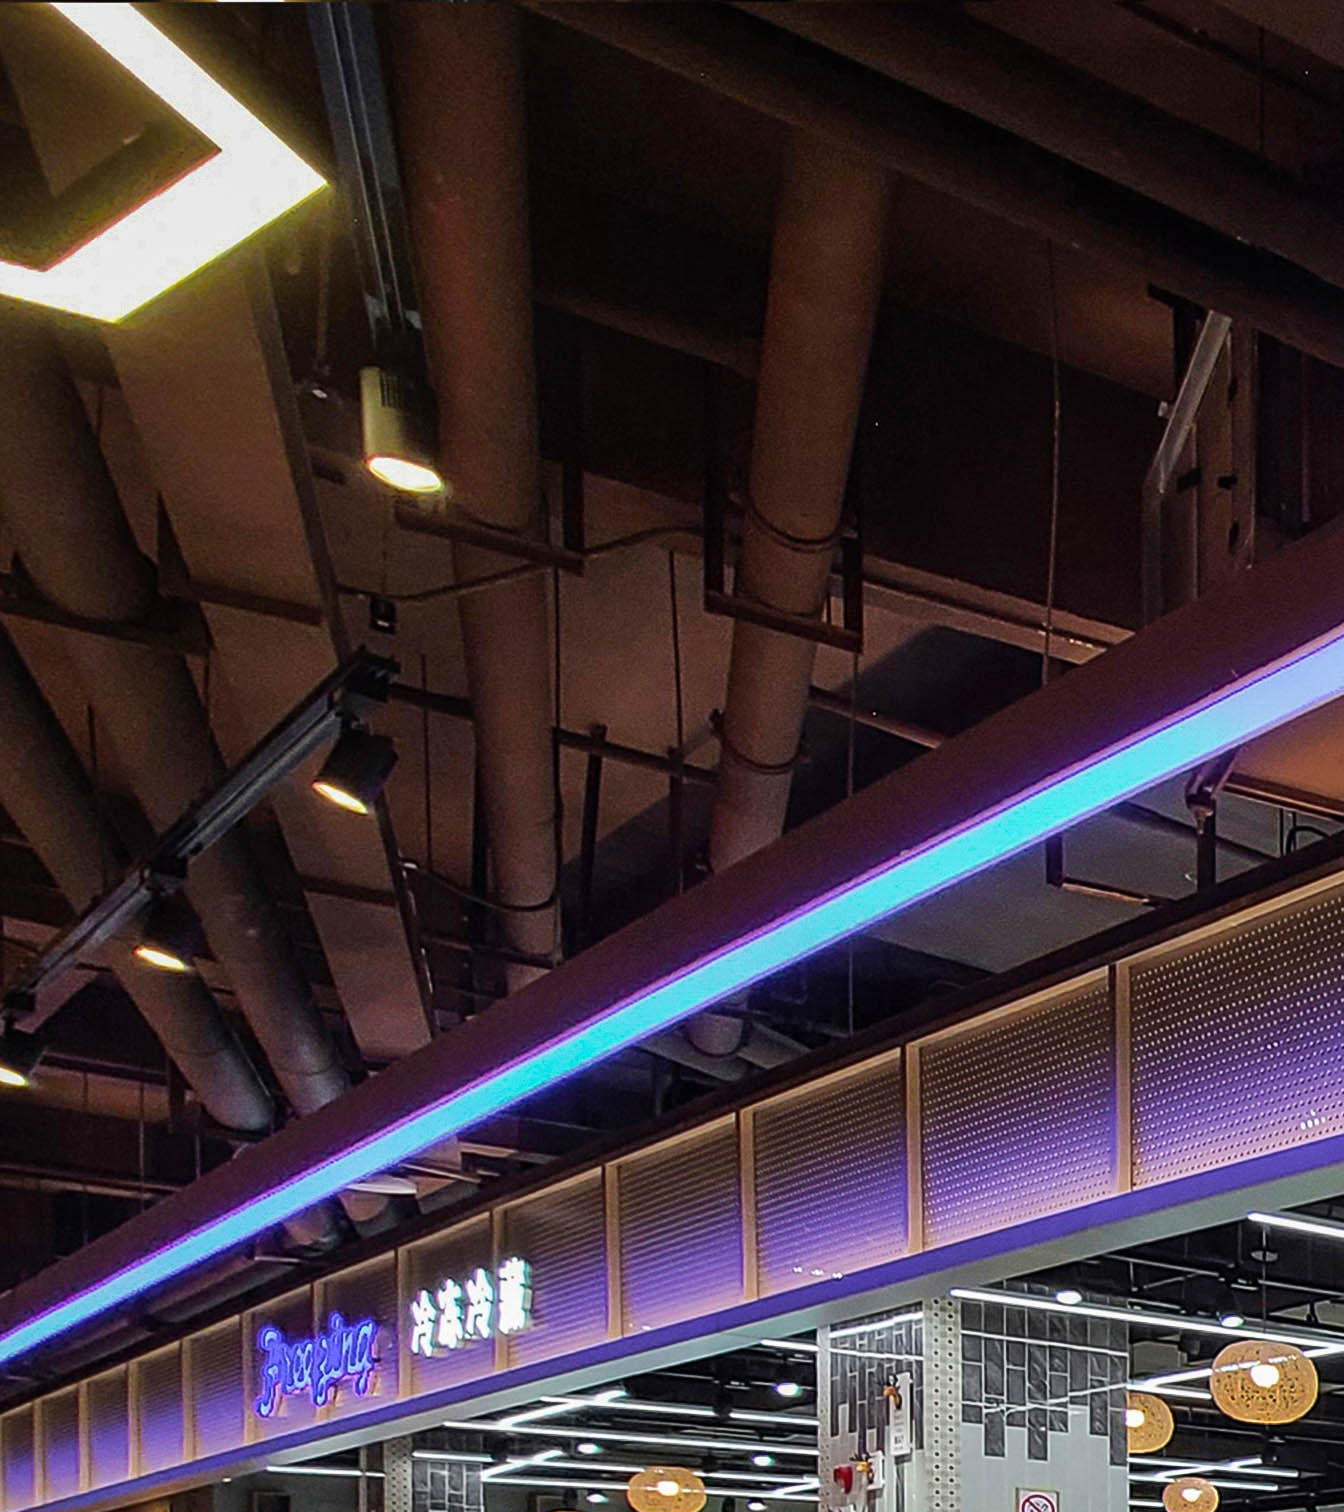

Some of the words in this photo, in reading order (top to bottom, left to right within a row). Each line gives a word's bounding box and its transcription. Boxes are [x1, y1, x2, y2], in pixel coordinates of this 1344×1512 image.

[410, 1256, 532, 1358] 冷冻冷藏
[255, 1312, 377, 1418] Freezing
